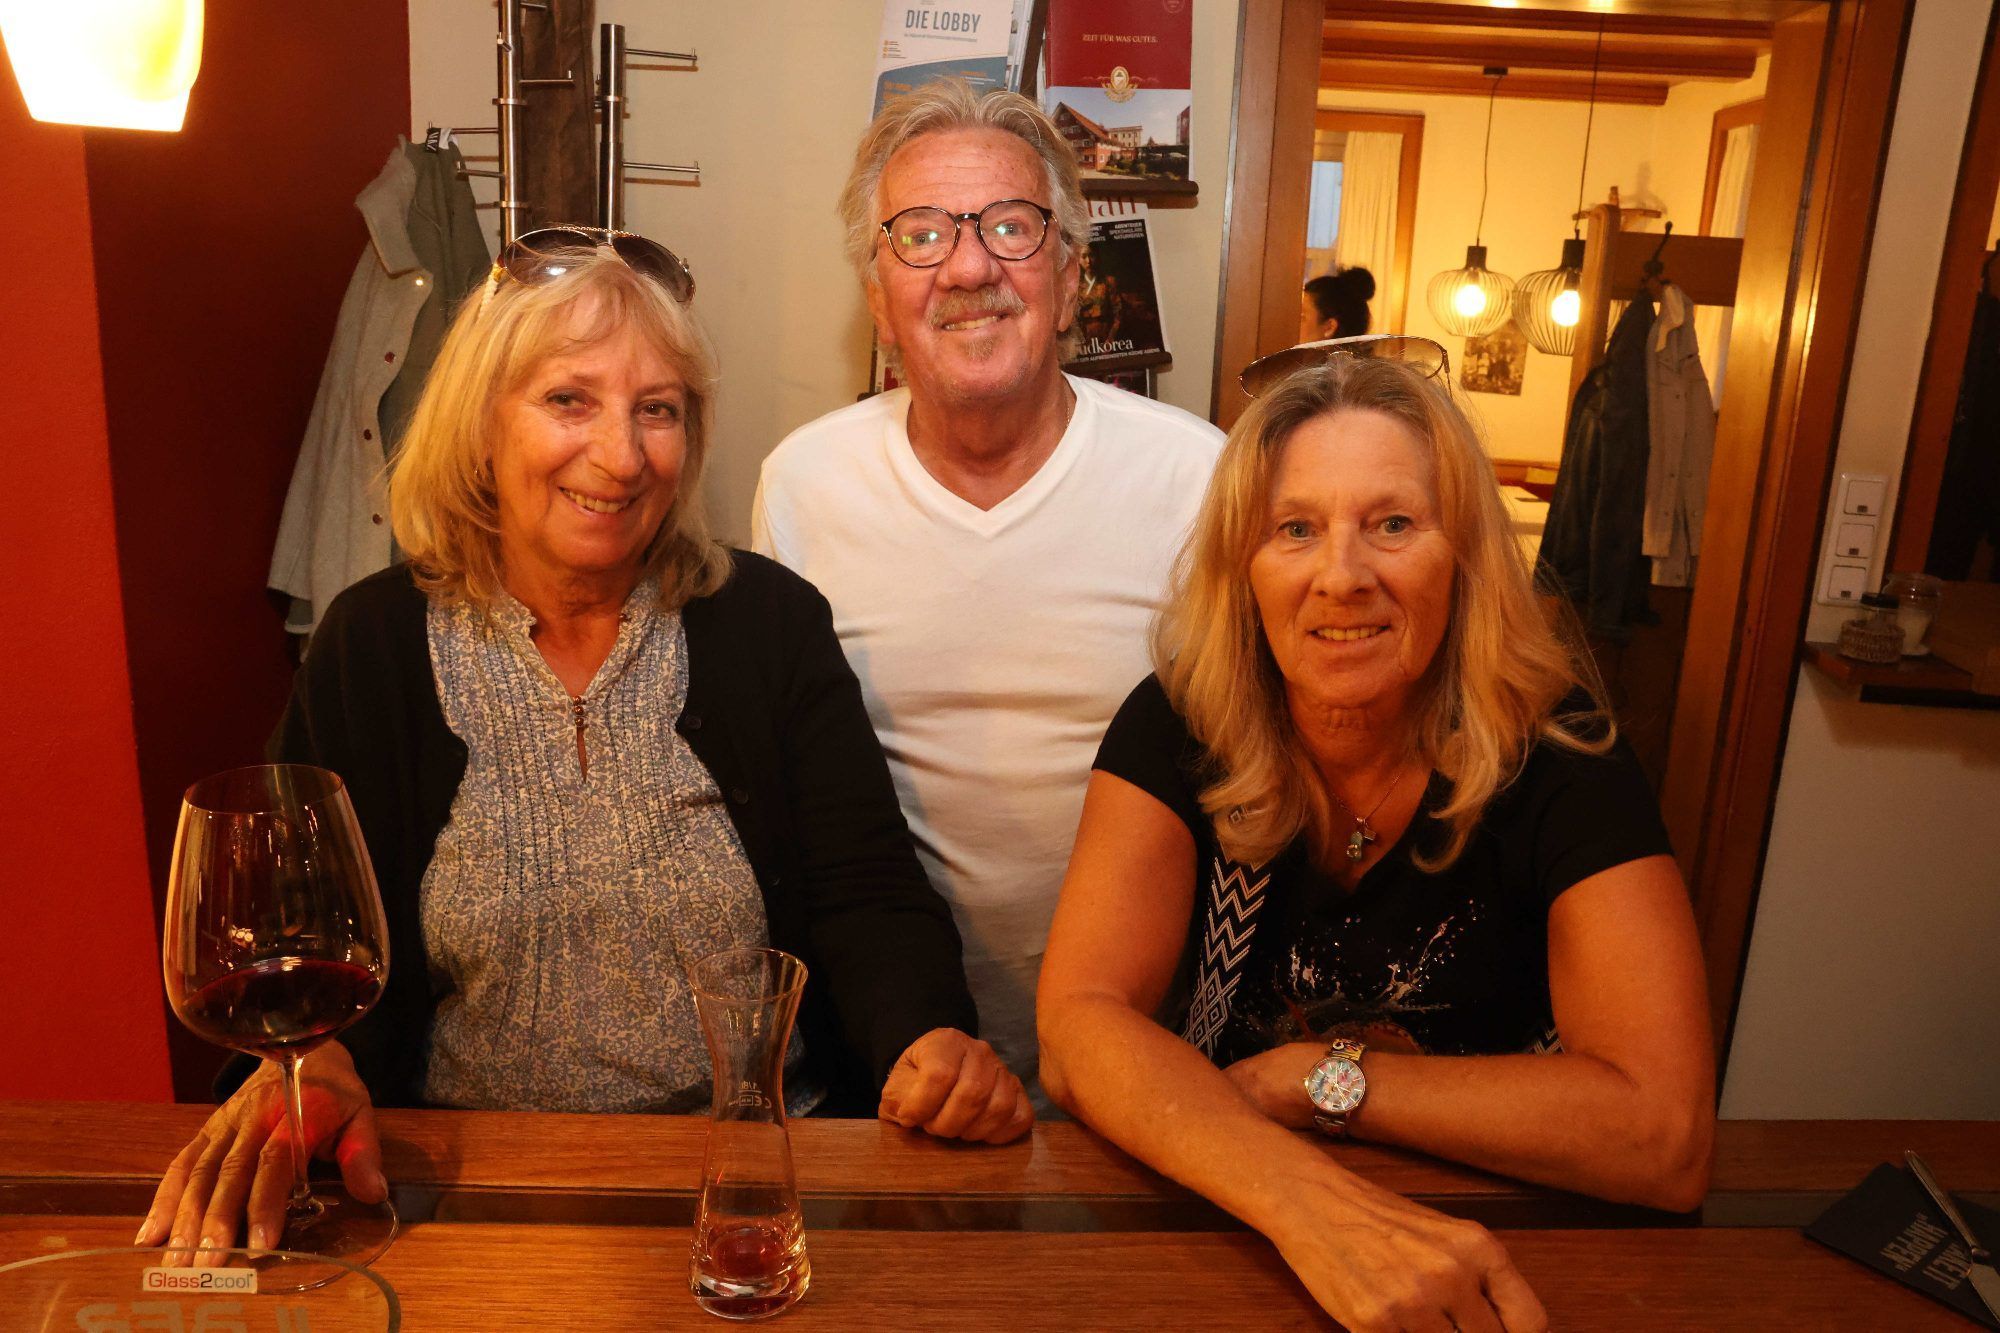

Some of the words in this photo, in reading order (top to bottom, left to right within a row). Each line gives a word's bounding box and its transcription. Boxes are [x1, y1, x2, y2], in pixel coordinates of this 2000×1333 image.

[905, 9, 930, 30] DIE
[932, 10, 982, 34] LOBBY
[1082, 33, 1098, 42] ZEIT
[1115, 34, 1132, 43] WAS
[1079, 336, 1134, 356] üdkorea
[148, 1272, 251, 1289] Glass2cool
